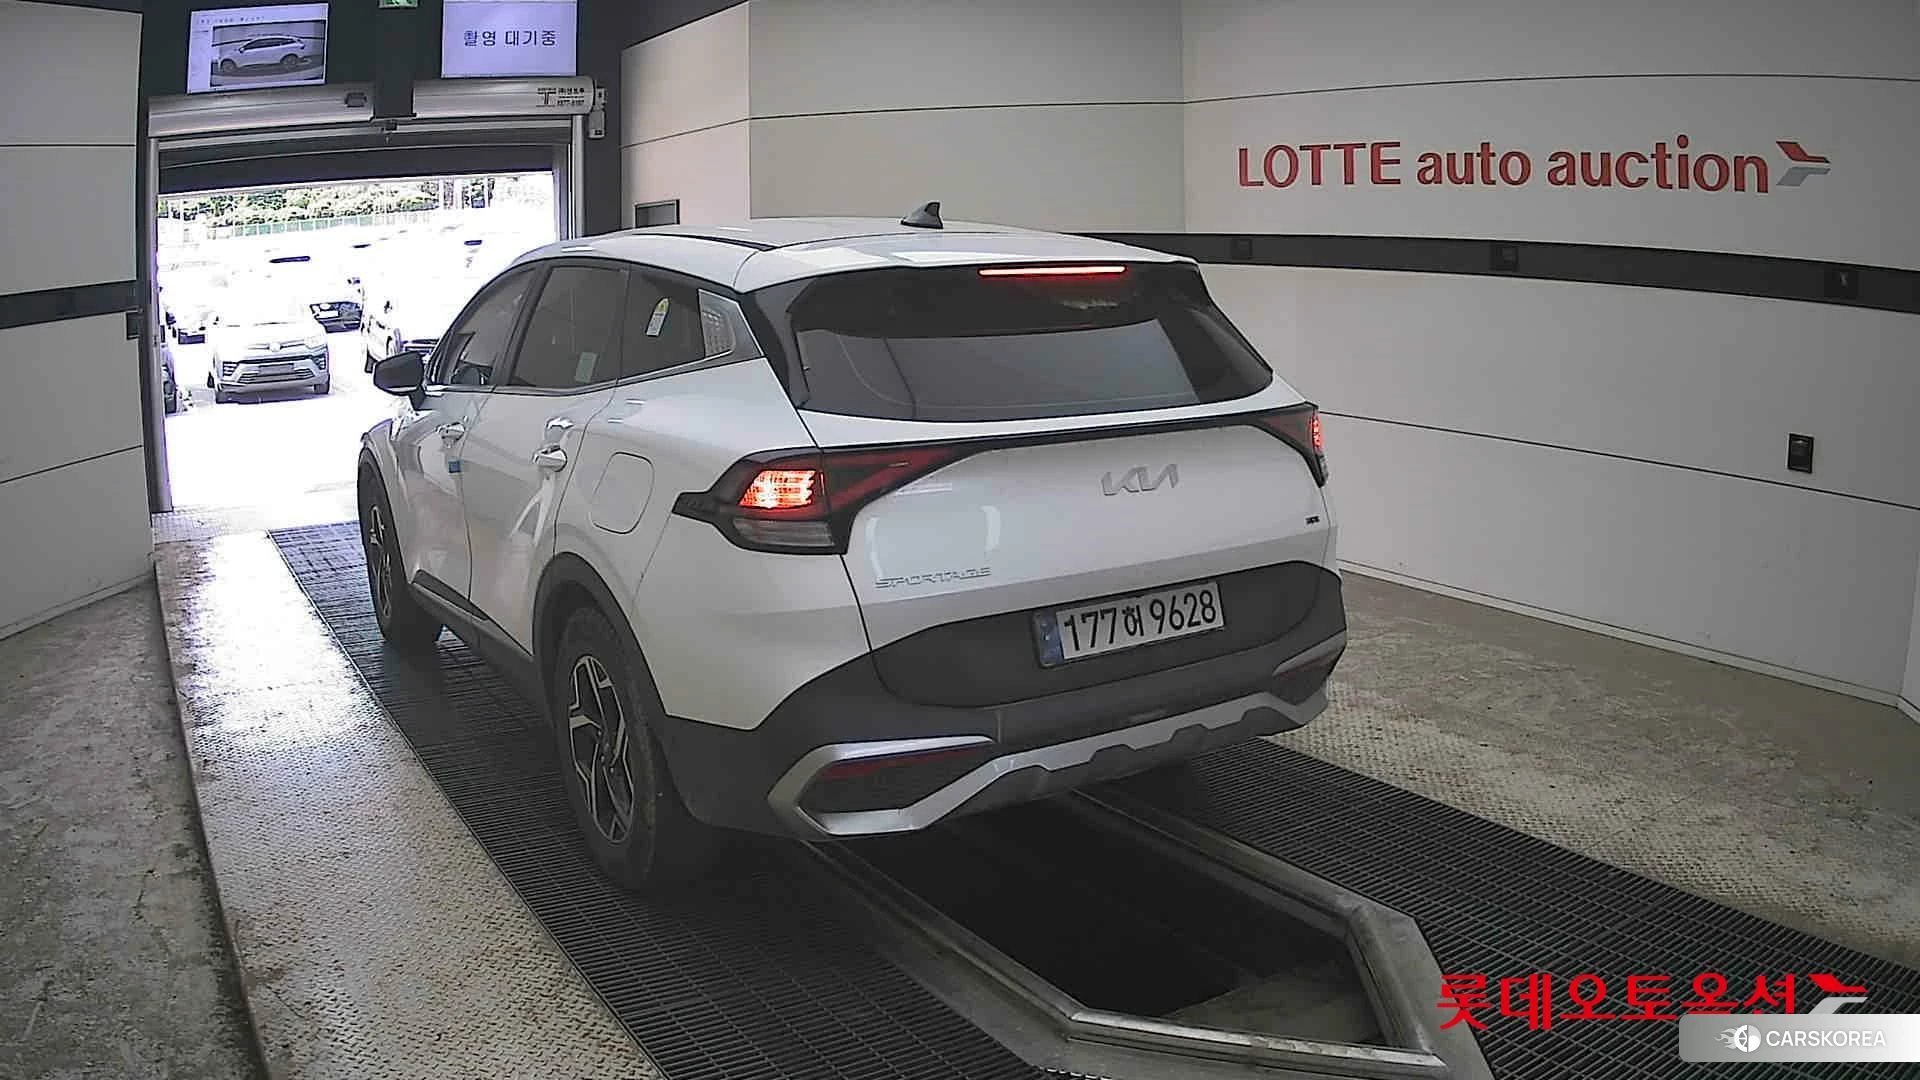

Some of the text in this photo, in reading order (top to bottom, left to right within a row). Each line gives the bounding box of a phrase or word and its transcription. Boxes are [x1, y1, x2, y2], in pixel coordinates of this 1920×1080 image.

[504, 30, 557, 47] 대기중
[1239, 134, 1769, 193] LOTTE auto auction
[875, 566, 992, 589] SPORTAGE
[1149, 589, 1217, 635] 9628
